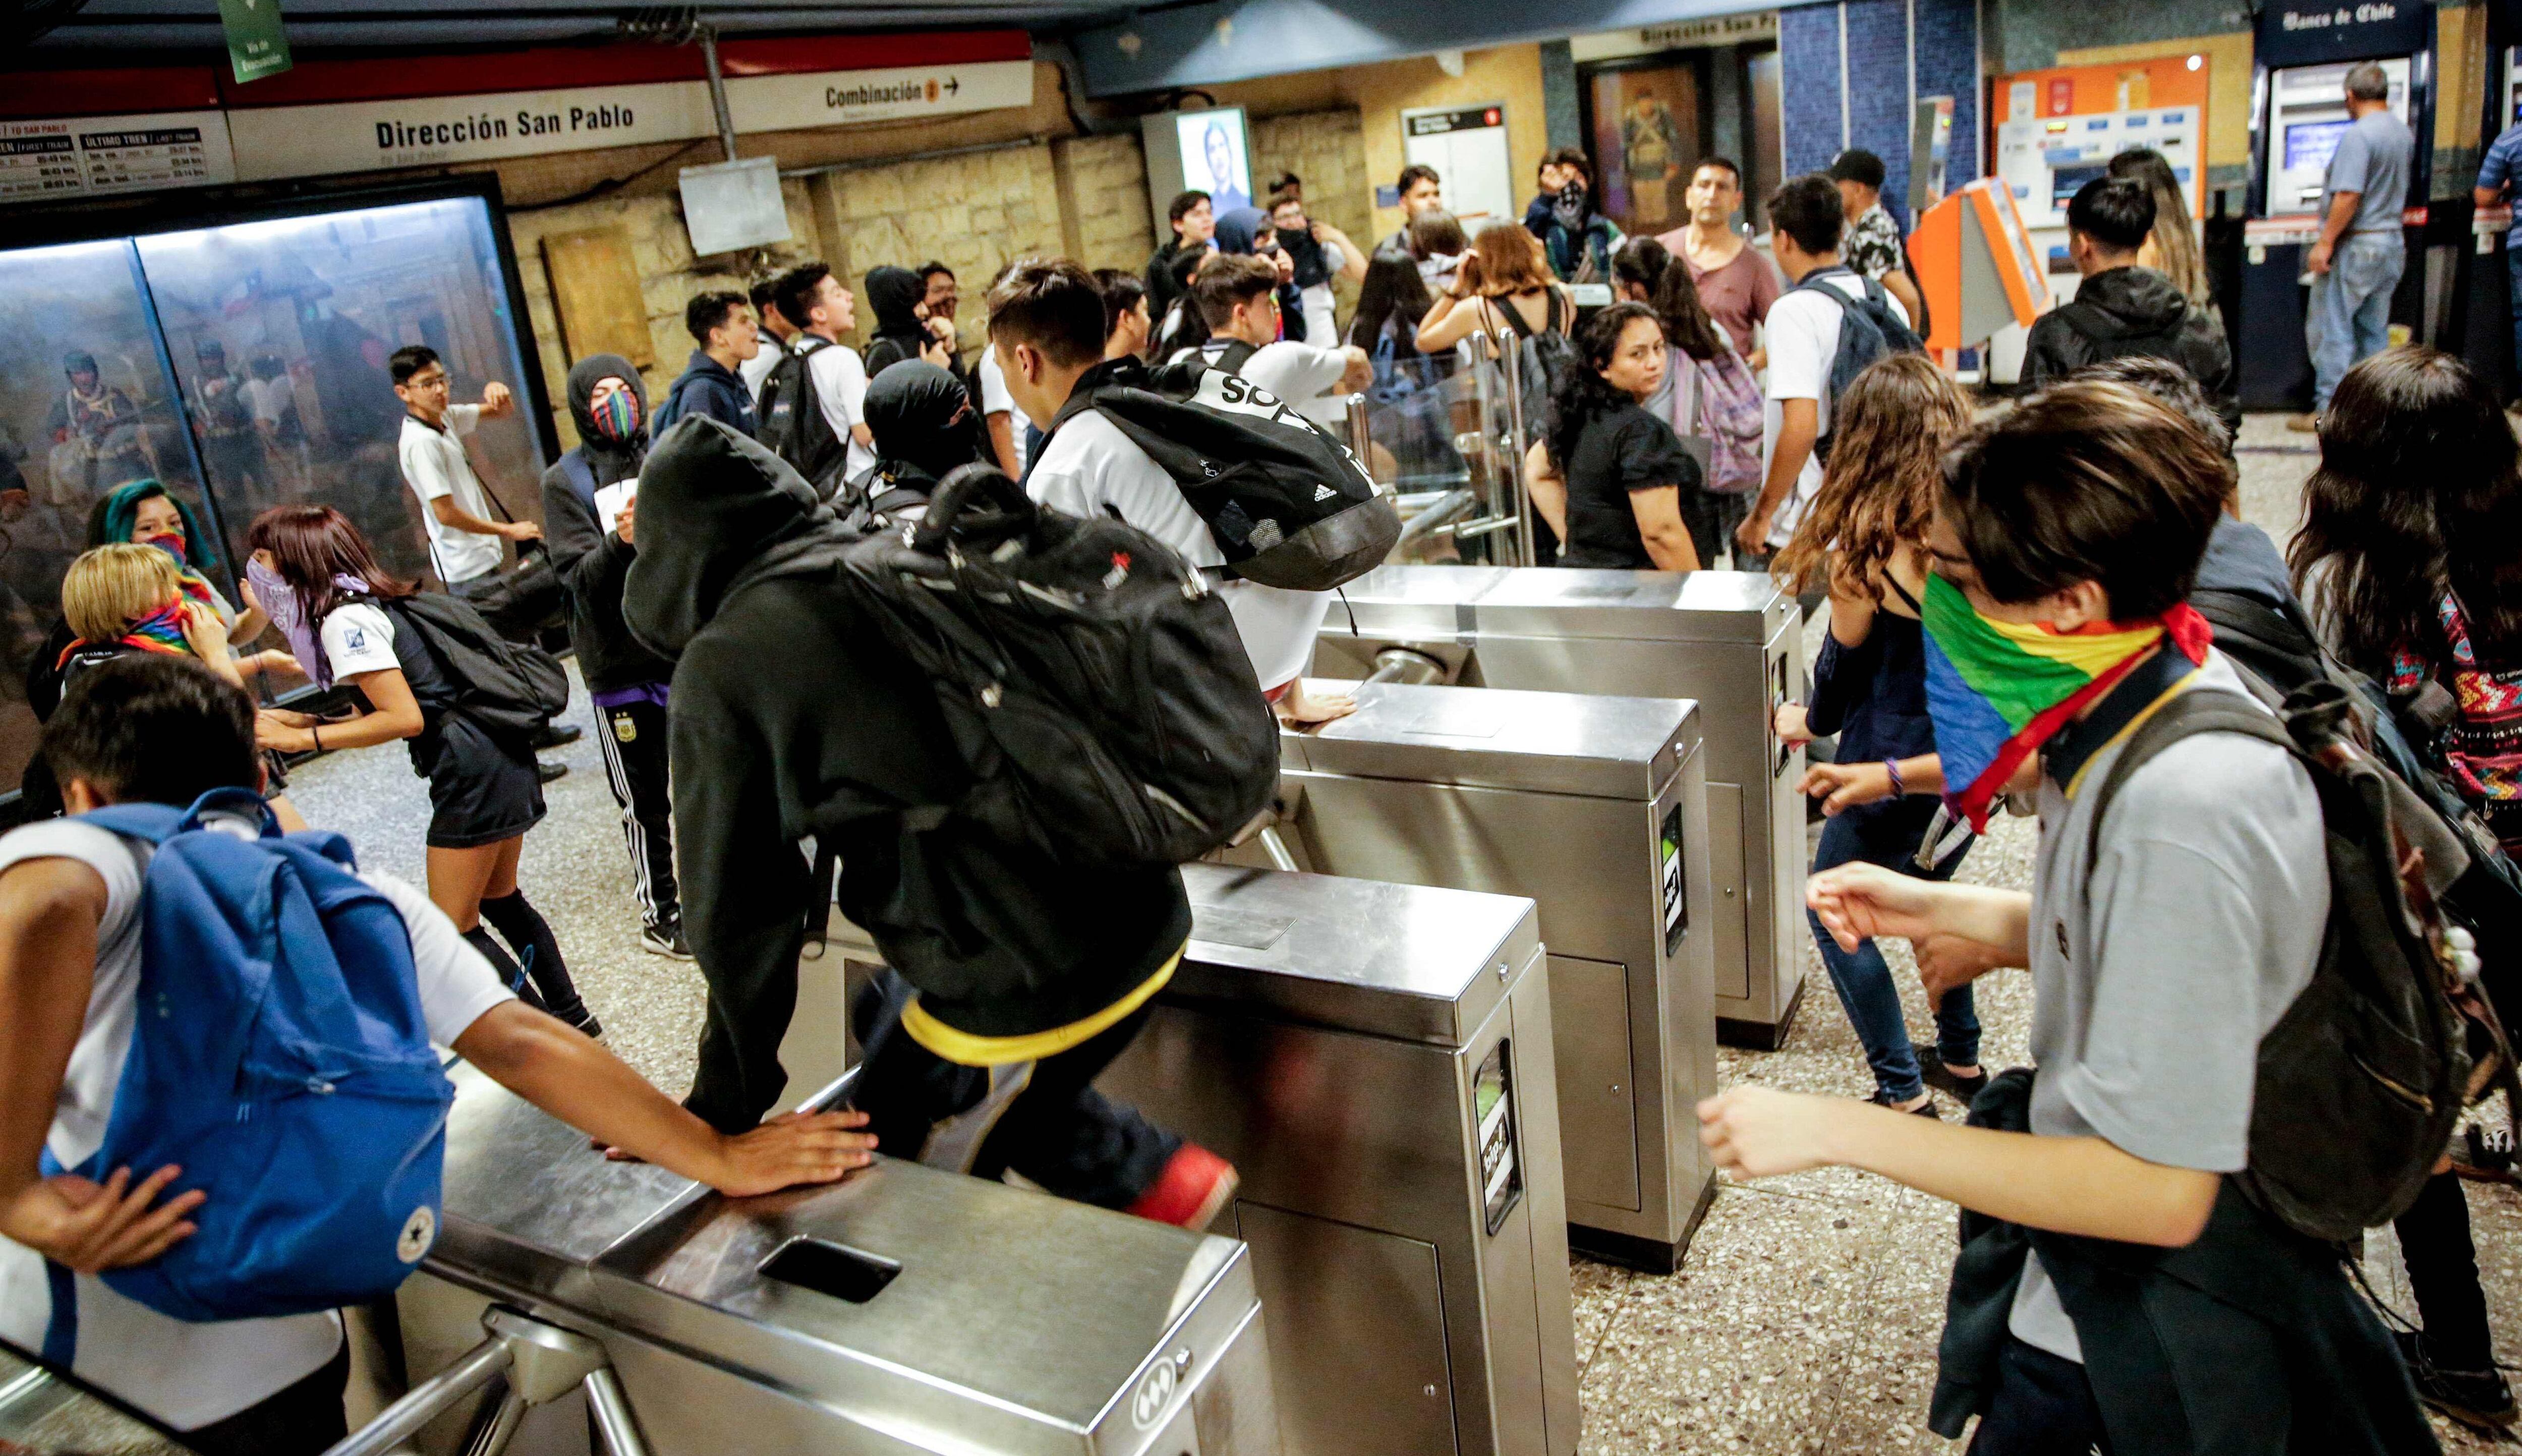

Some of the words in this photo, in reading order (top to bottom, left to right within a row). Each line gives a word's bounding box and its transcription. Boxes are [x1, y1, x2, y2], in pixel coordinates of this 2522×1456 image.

[2283, 11, 2331, 30] Banco
[2335, 7, 2352, 25] de
[2356, 2, 2396, 23] Chile
[826, 80, 922, 107] Combinación
[376, 113, 507, 149] Dirección
[517, 110, 561, 136] San
[570, 103, 634, 131] Pablo
[1483, 1121, 1504, 1174] bip!
